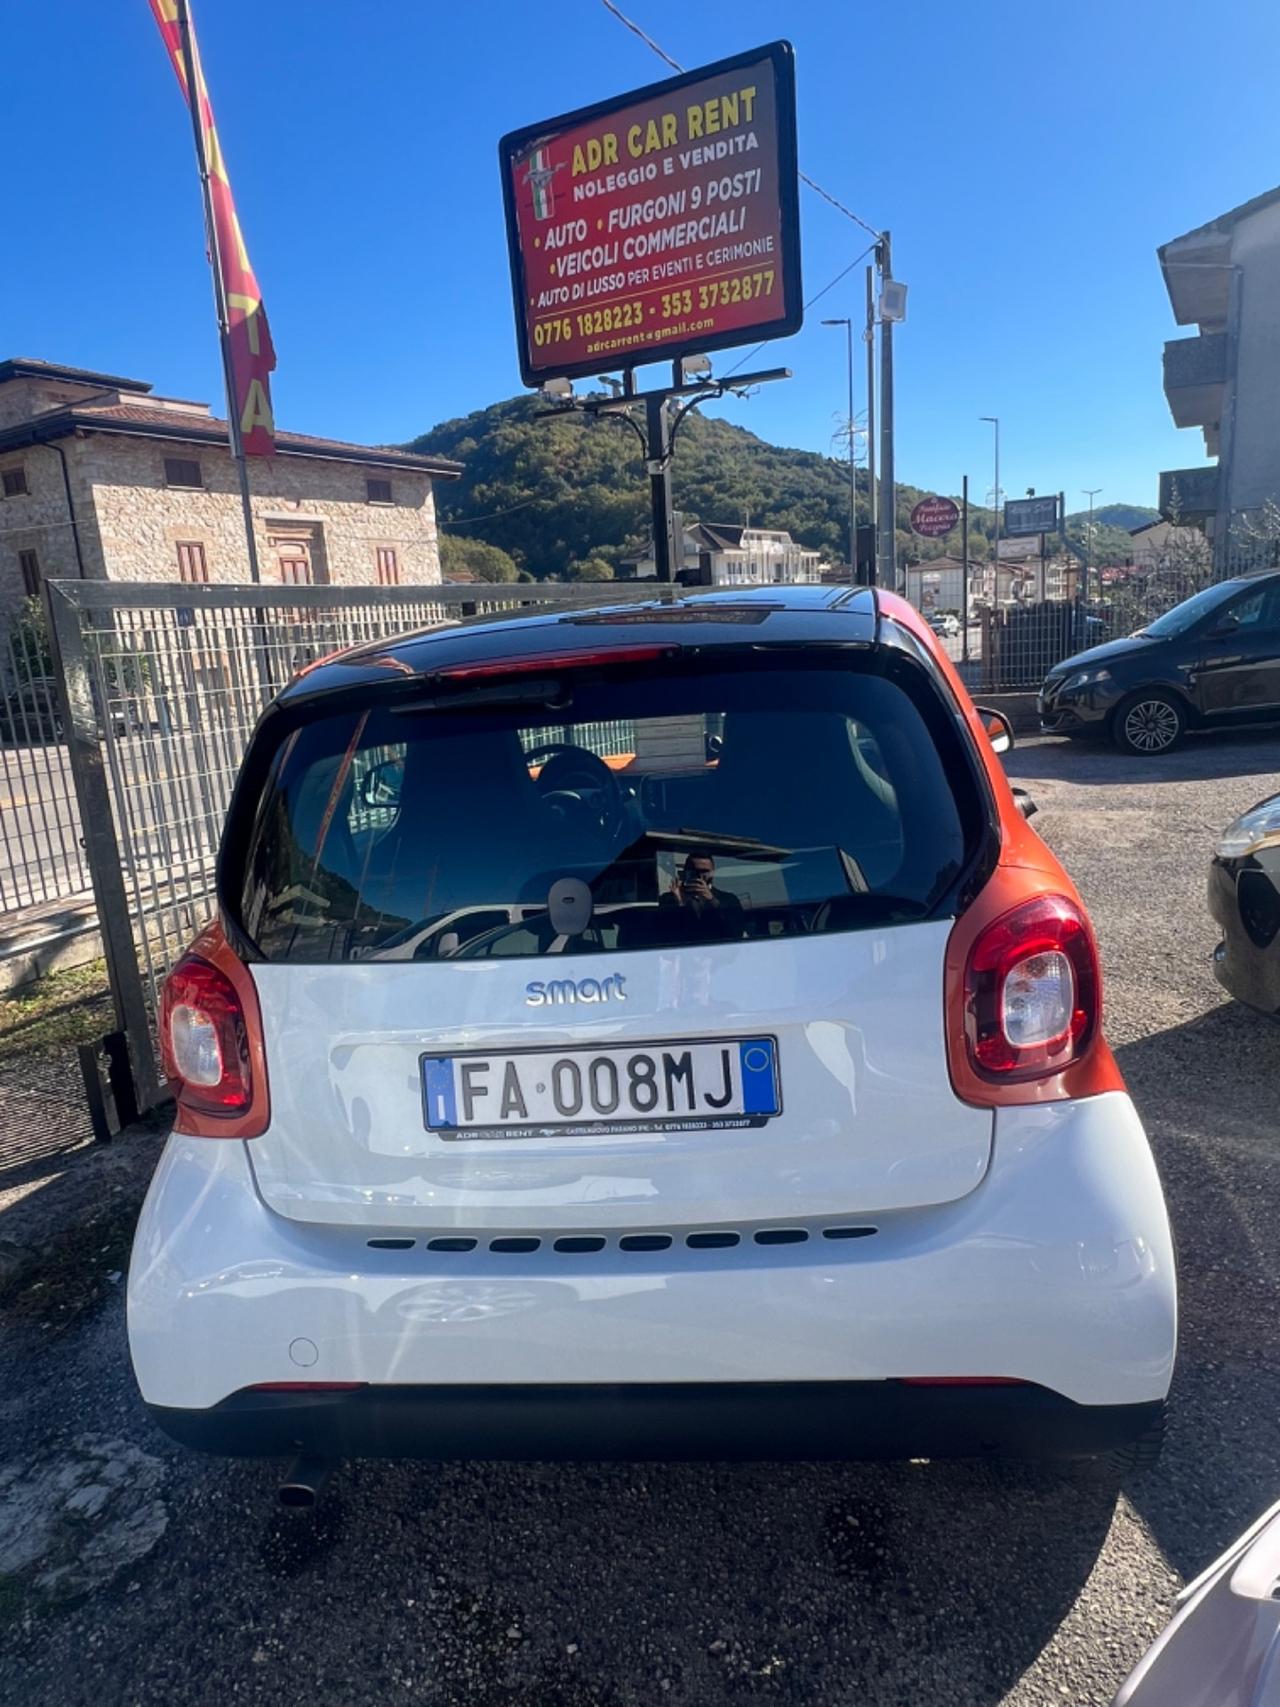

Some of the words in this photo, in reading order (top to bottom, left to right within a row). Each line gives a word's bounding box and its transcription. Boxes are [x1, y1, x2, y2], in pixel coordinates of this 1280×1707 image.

[572, 133, 619, 177] ADR
[627, 113, 678, 158] CAR
[687, 86, 756, 140] RENT
[573, 163, 657, 202] NOLEGGIO
[663, 157, 674, 176] E
[679, 131, 759, 170] VENDITA
[544, 219, 587, 251] AUTO
[608, 189, 686, 233] FURGONI
[691, 185, 701, 210] 9
[706, 167, 762, 206] POSTI
[556, 241, 619, 278] VEICOLI
[623, 206, 746, 260] COMMERCIALI
[534, 318, 572, 346] 0776
[576, 301, 643, 337] 1828223
[661, 289, 692, 318] 353
[698, 270, 774, 310] 3732877
[537, 286, 569, 308] AUTO
[571, 282, 585, 300] DI
[586, 272, 625, 297] LUSSO
[627, 268, 650, 286] PER
[652, 256, 693, 280] EVENTI
[695, 253, 704, 269] E
[705, 236, 774, 266] CERIMONIE
[526, 972, 626, 1007] smart
